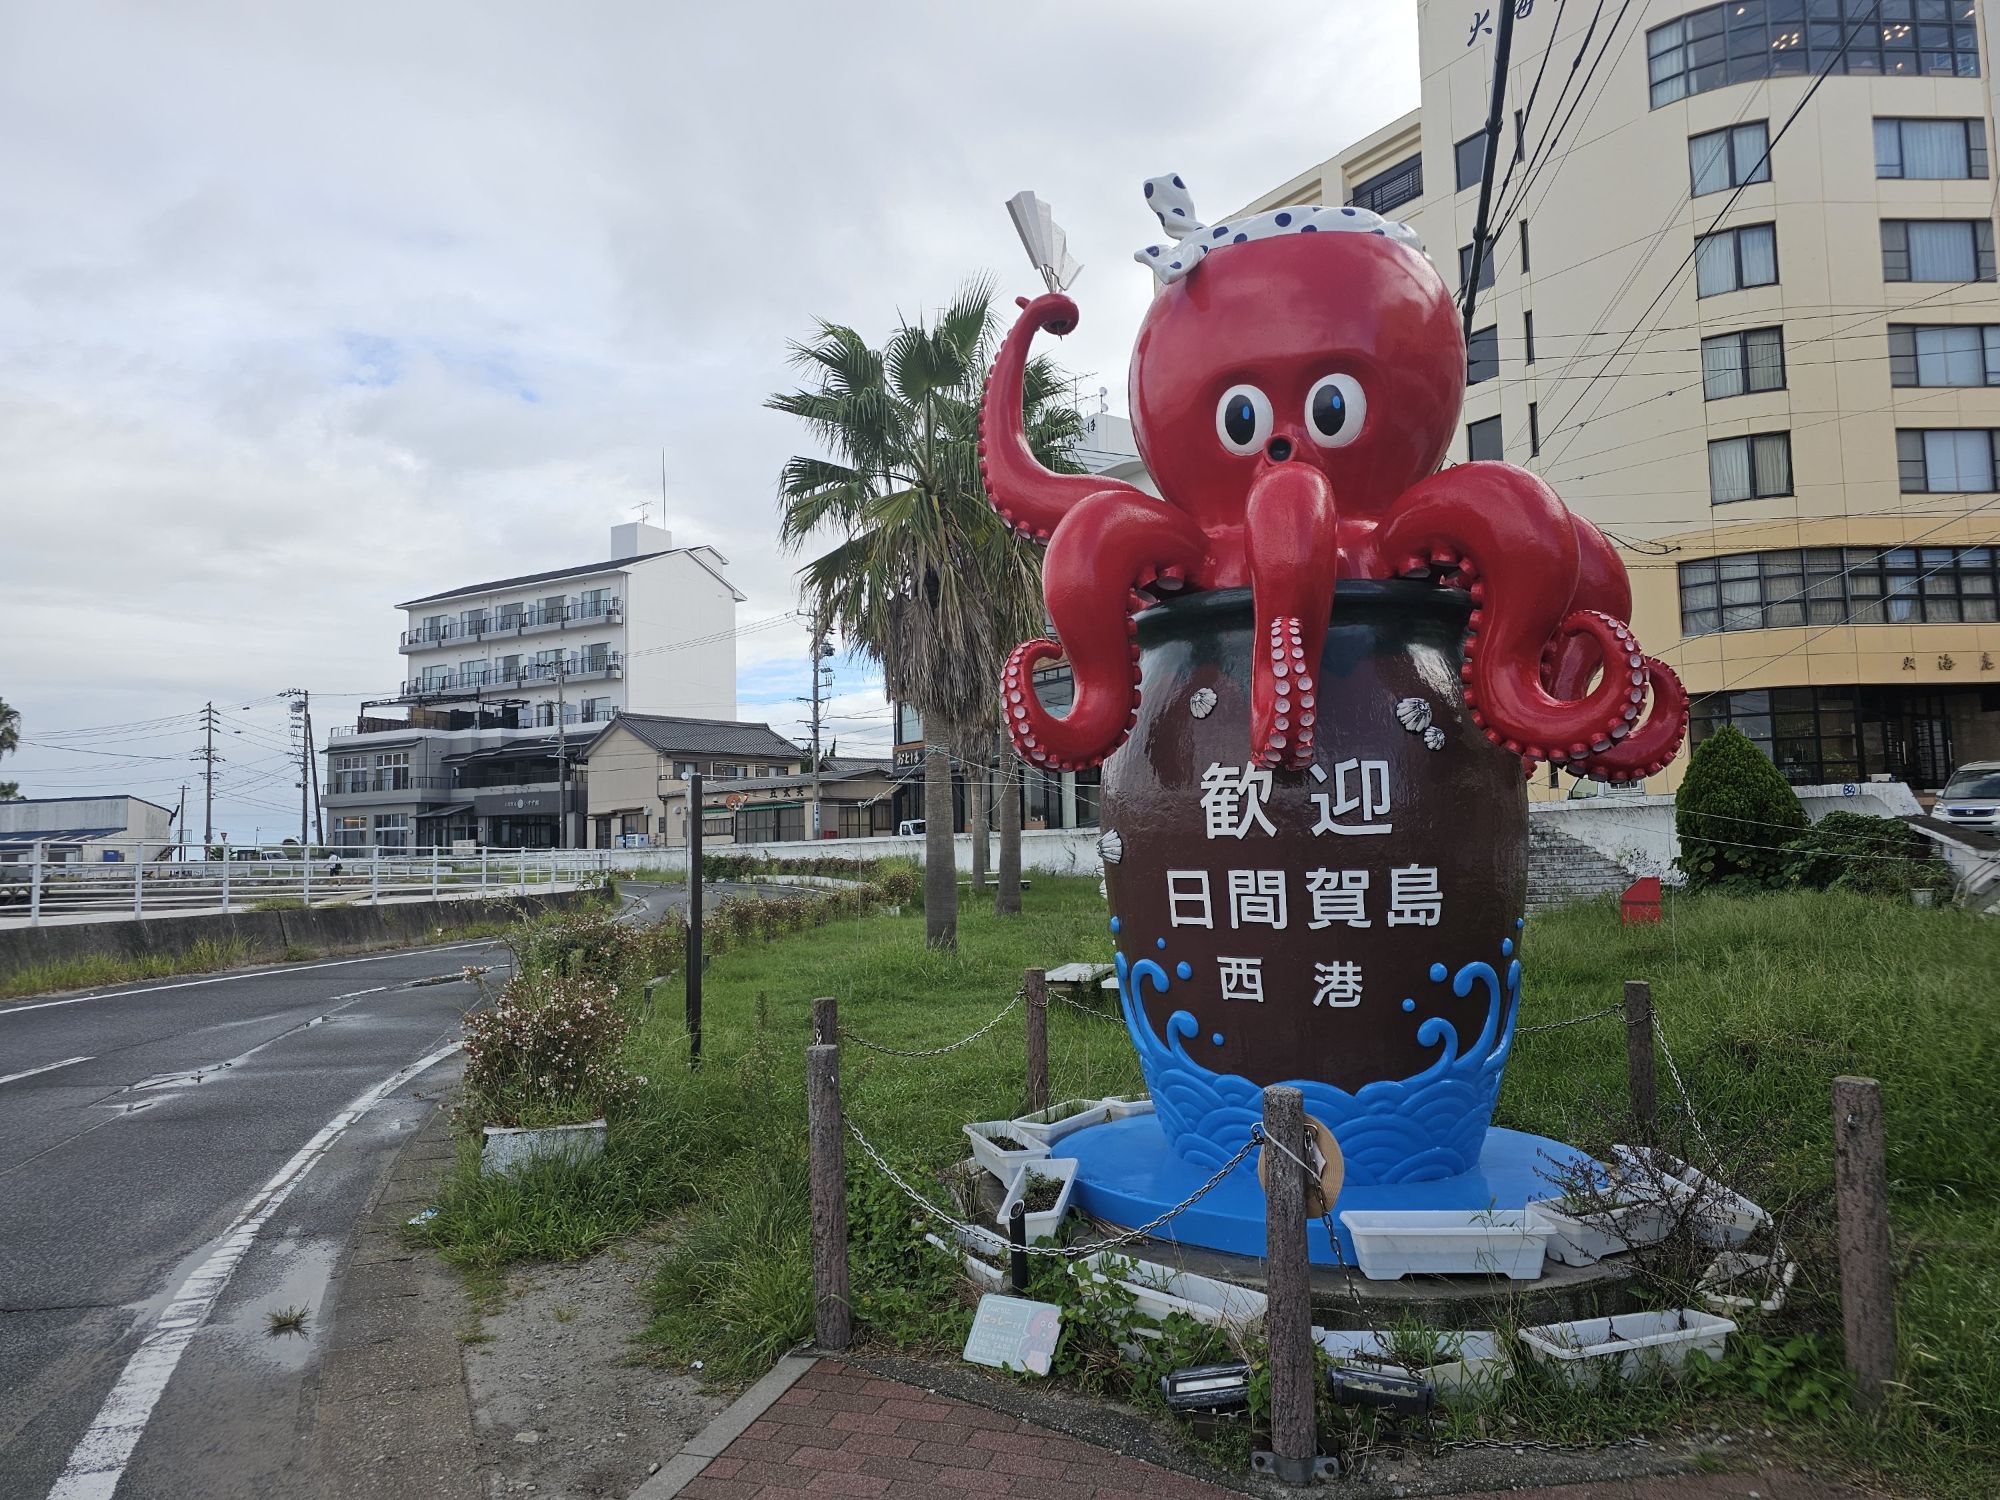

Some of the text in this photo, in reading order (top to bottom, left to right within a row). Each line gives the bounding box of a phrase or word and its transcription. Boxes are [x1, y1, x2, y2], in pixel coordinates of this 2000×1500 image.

[1200, 757, 1393, 840] 歓迎
[1165, 863, 1444, 931] 日間賀島
[1216, 955, 1364, 1009] 西港
